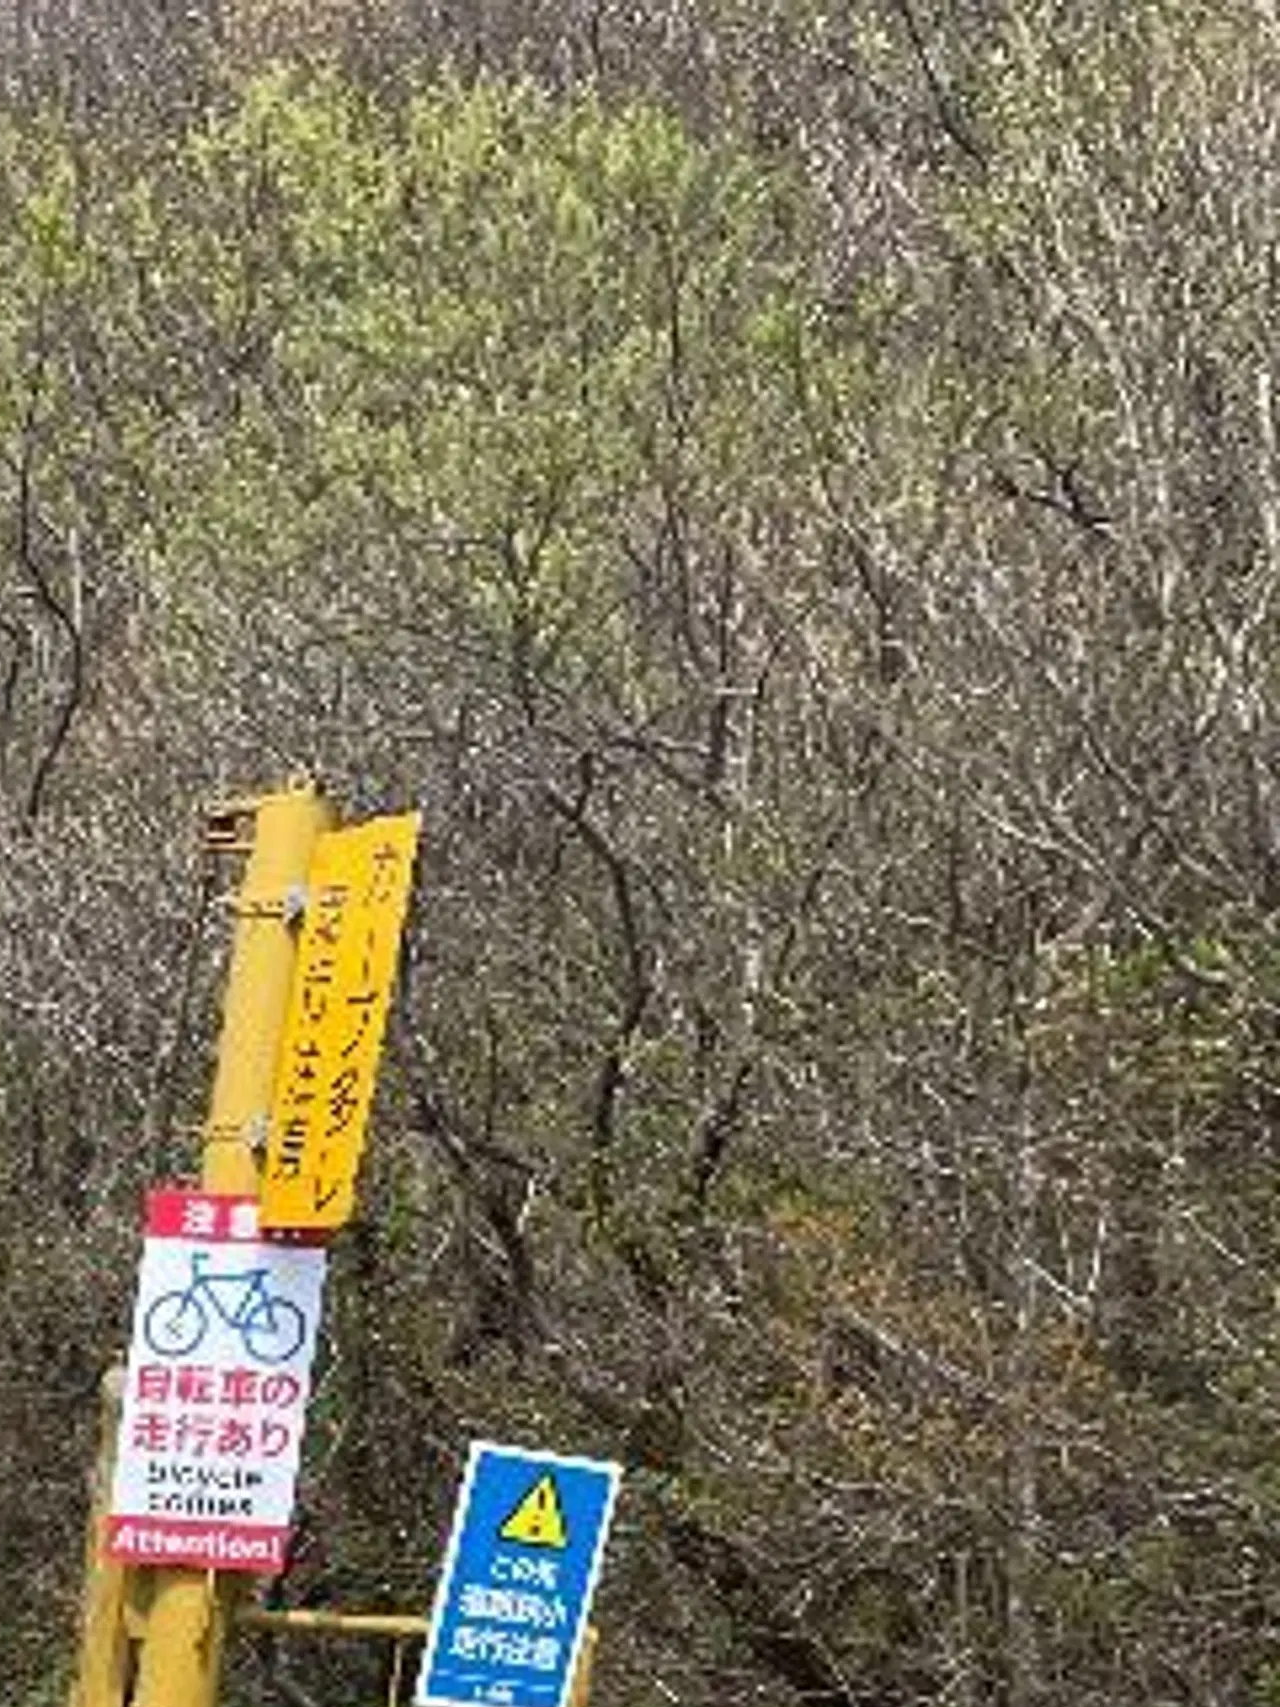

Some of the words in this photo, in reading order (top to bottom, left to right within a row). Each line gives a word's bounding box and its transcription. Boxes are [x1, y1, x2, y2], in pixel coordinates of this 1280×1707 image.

[137, 1365, 301, 1410] 自転車の
[131, 1413, 291, 1458] 走行あり
